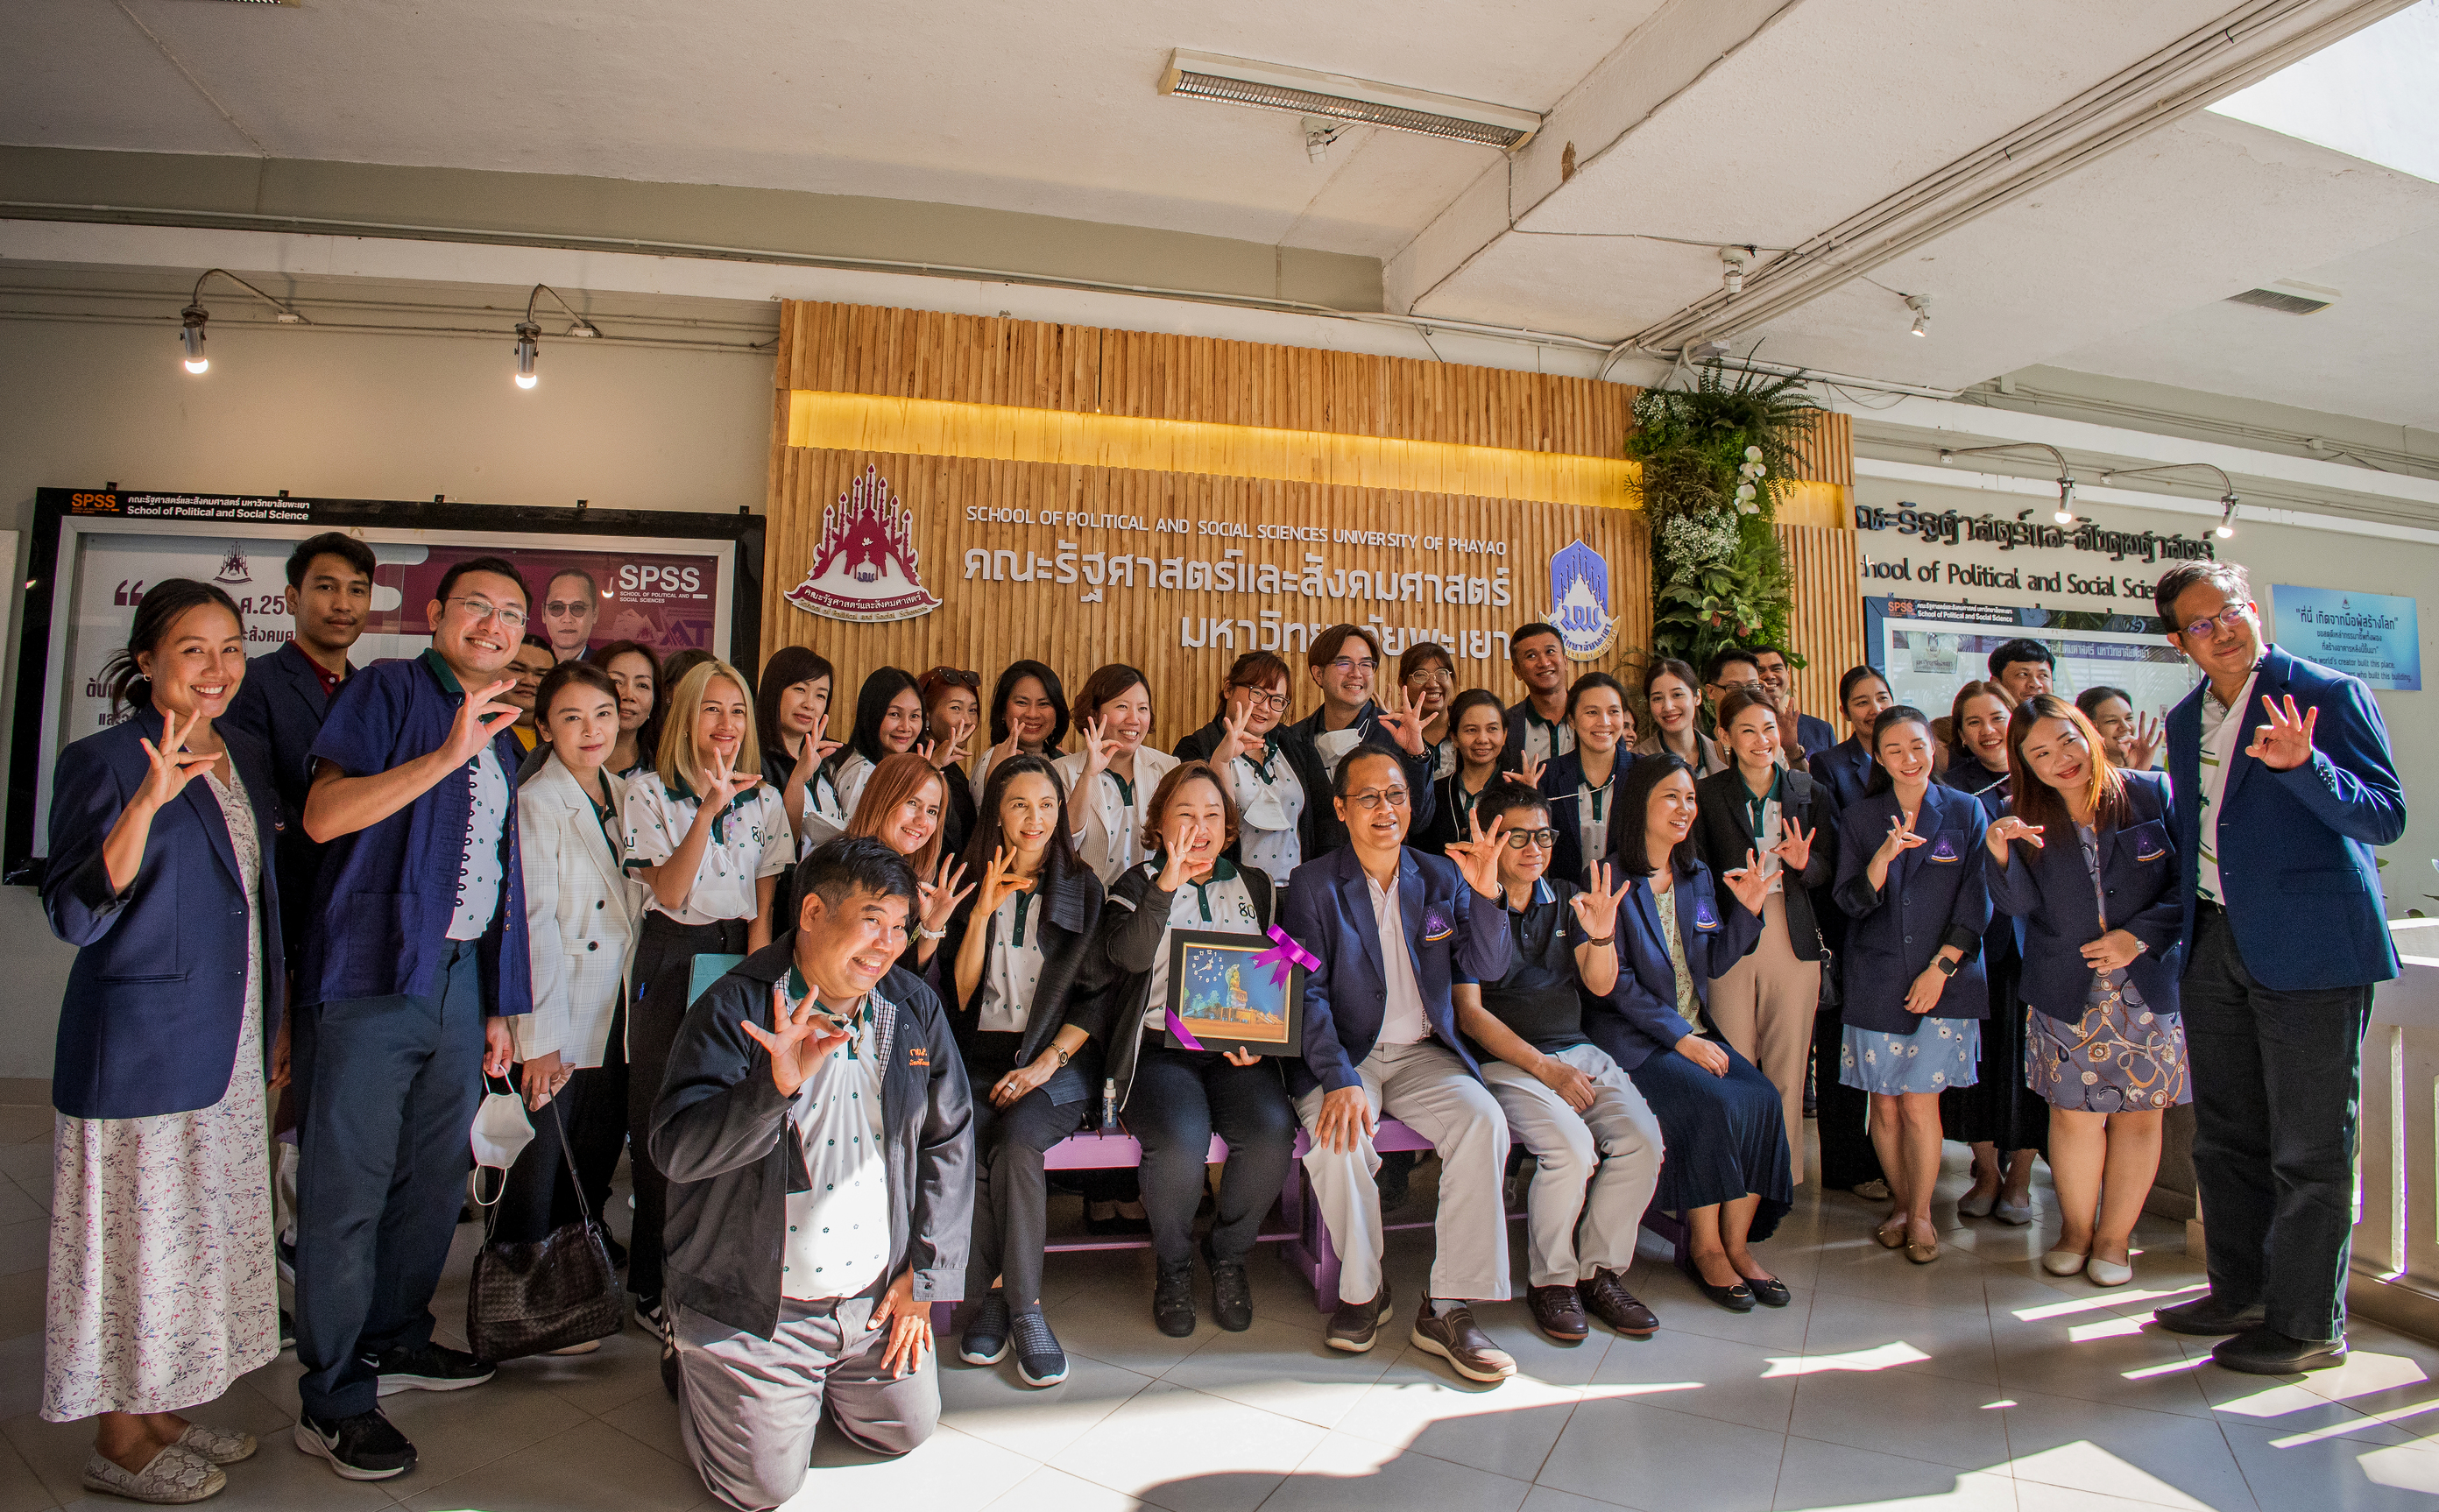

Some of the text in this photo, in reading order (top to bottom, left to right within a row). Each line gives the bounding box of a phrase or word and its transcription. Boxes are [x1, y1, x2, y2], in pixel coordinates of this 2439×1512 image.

[72, 493, 116, 508] SPSS
[128, 495, 310, 509] คณะรัฐศาสตร์และสังคมศาสตร์ มหาวิทยาลัยพะเยา
[127, 505, 309, 520] School of Political and Social Science
[965, 505, 1507, 555] SCHOOL OF POLITICAL AND SOCIAL SCIENCES UNIVERSITY OF PHAYAO
[1856, 501, 2215, 562] ณะรัฐศาสตร์และสังคมศาสตร์
[619, 564, 700, 592] SPSS
[964, 539, 1511, 607] คณะรัฐศาสตร์และสังคมศาสตร์
[1861, 554, 2157, 599] hool of Political and Social Scie
[804, 589, 922, 610] คณะรัฐศาสตร์และสังคมศาสตร์
[1888, 601, 1913, 612] SPSS
[1992, 614, 2013, 623] Science
[751, 825, 766, 847] 80
[1238, 902, 1255, 919] 80
